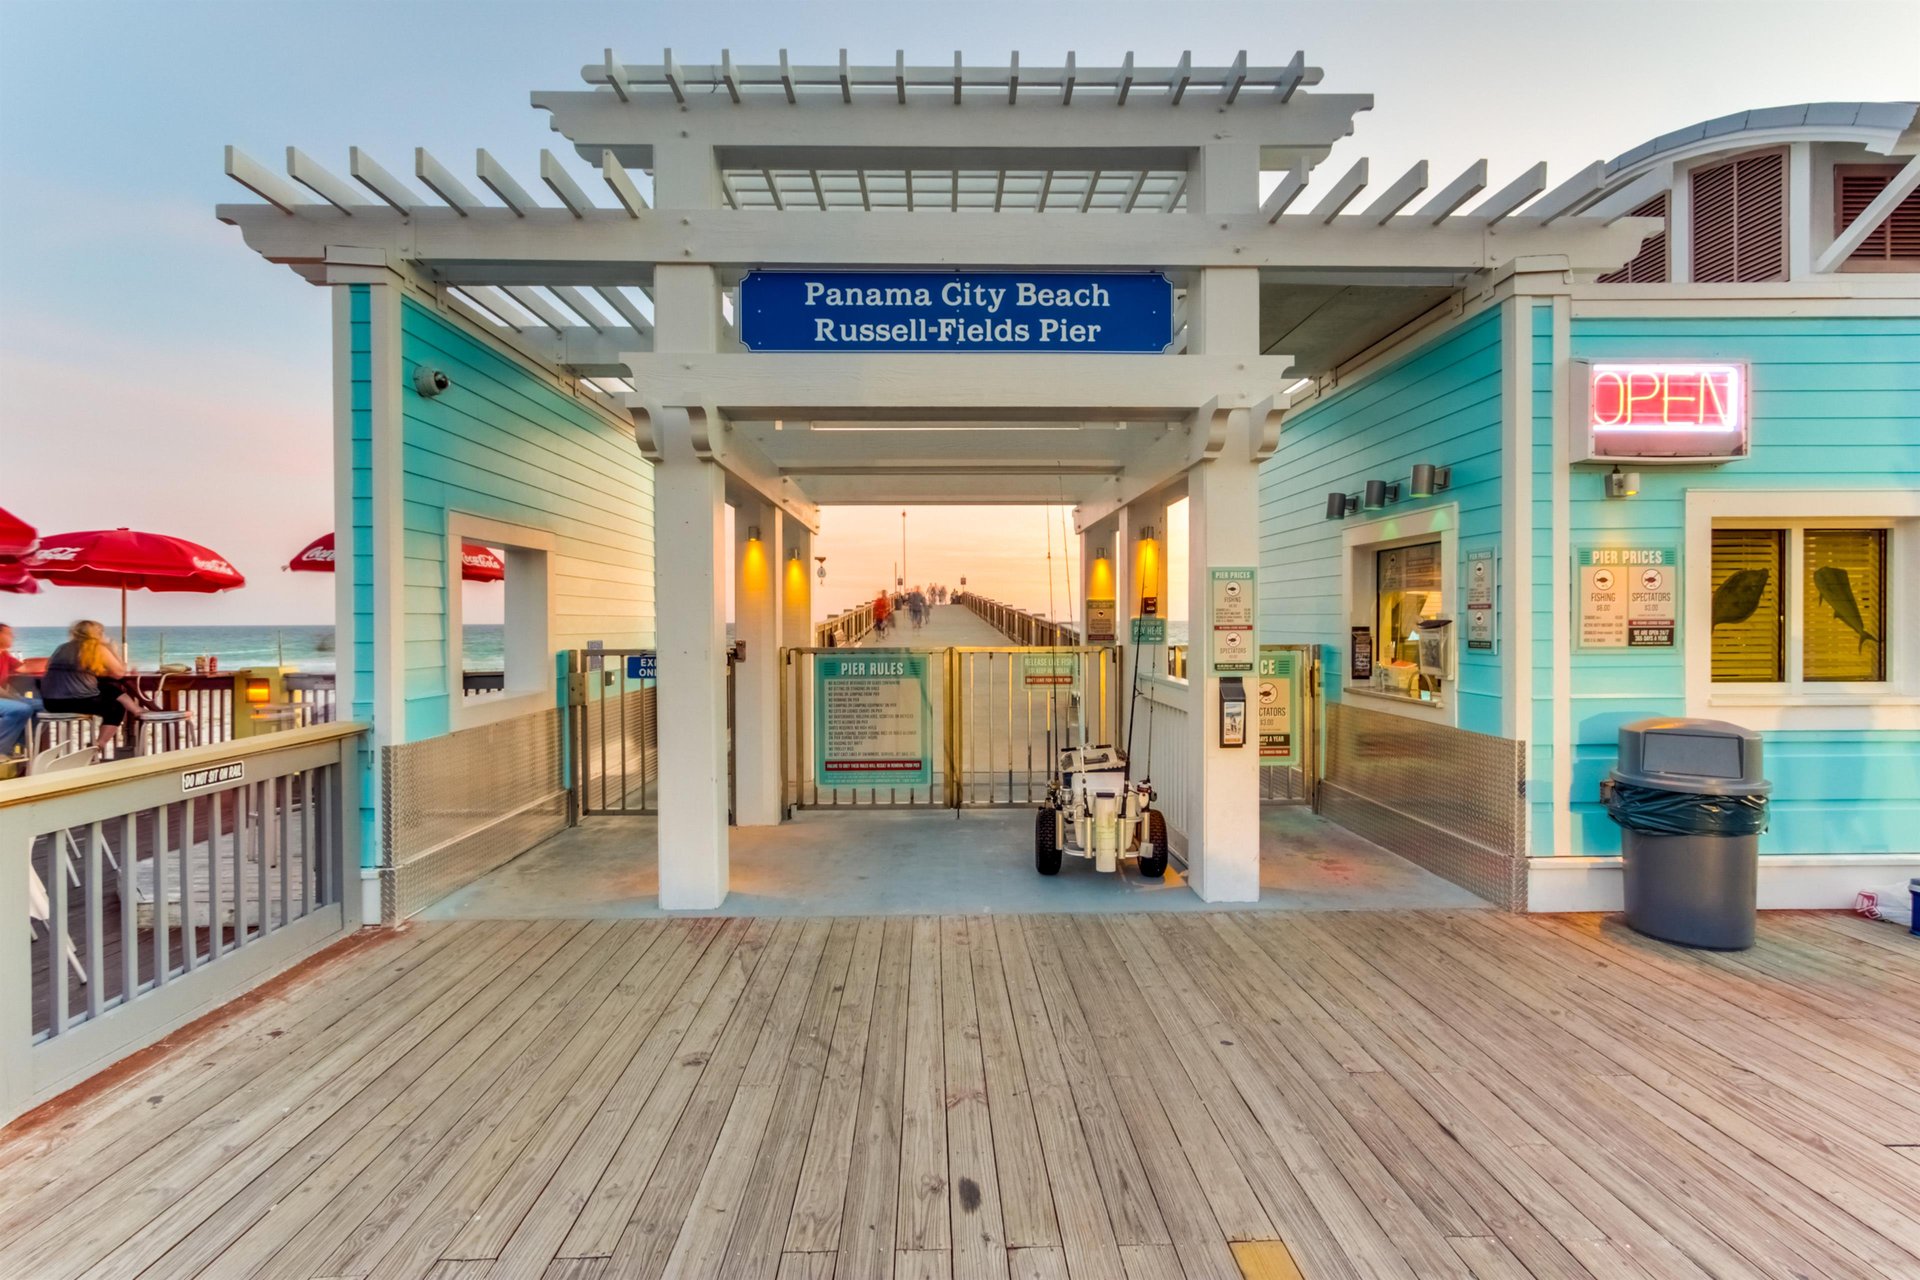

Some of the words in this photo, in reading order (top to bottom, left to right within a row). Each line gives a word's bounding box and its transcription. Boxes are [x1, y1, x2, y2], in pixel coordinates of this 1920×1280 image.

[805, 282, 932, 307] Panama
[941, 282, 1006, 312] City
[1016, 283, 1110, 307] Beach
[814, 318, 1029, 341] Russell-Fields
[1039, 319, 1101, 342] Pier
[1593, 371, 1734, 426] OPEN
[1593, 550, 1618, 564] PIER
[1622, 550, 1663, 564] PRICES
[1231, 571, 1250, 579] PRICES
[1591, 592, 1616, 602] FISHING
[1632, 592, 1671, 602] SPECTATORS
[1134, 627, 1146, 635] PY
[841, 662, 865, 675] PIER
[870, 662, 904, 675] RULES
[186, 774, 195, 788] DO
[195, 770, 208, 786] NOT
[208, 769, 219, 783] SIT
[219, 767, 229, 781] ON
[228, 764, 242, 779] RAIL
